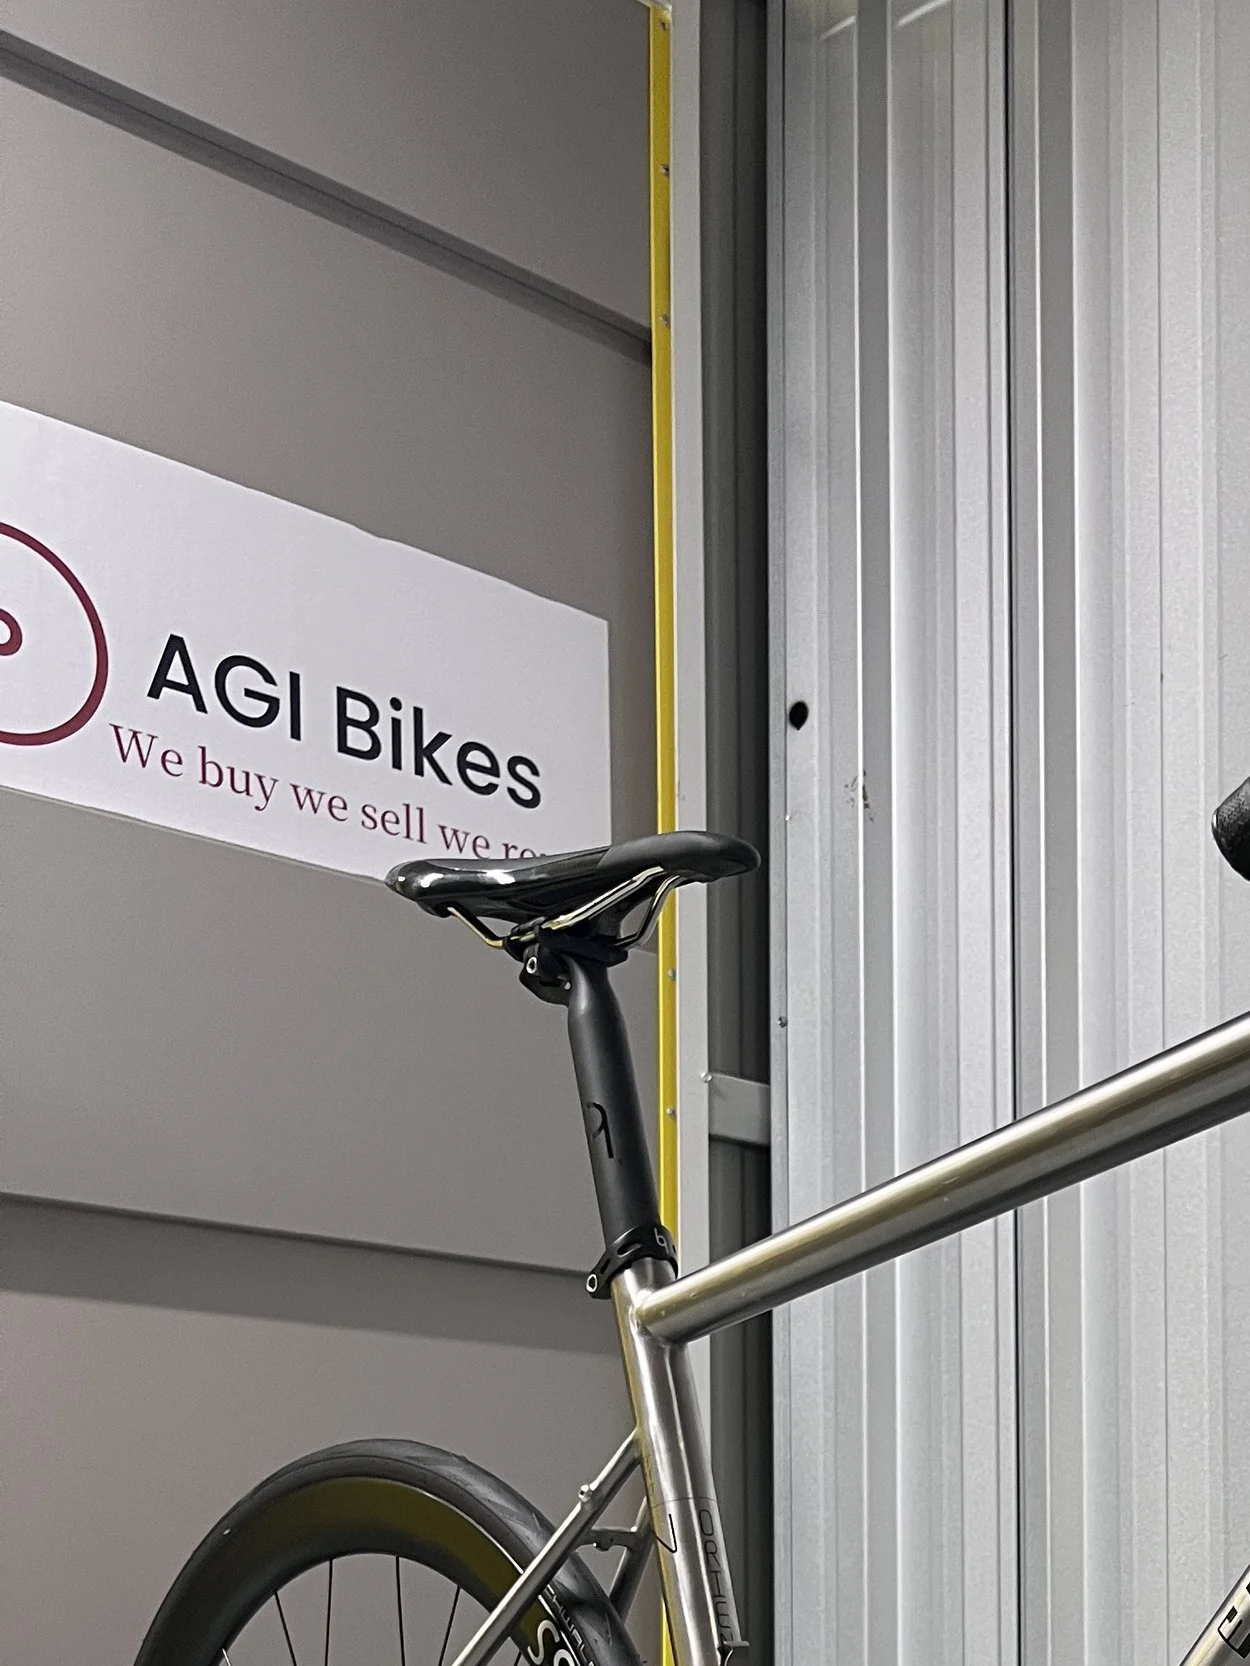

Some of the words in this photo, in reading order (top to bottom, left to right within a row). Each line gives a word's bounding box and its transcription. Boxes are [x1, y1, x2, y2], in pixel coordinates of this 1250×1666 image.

[109, 723, 184, 777] We
[198, 746, 279, 811] buy
[290, 783, 349, 822] we
[361, 803, 428, 844] sell
[438, 824, 491, 859] we
[147, 633, 301, 742] AGI
[336, 686, 542, 809] Bikes
